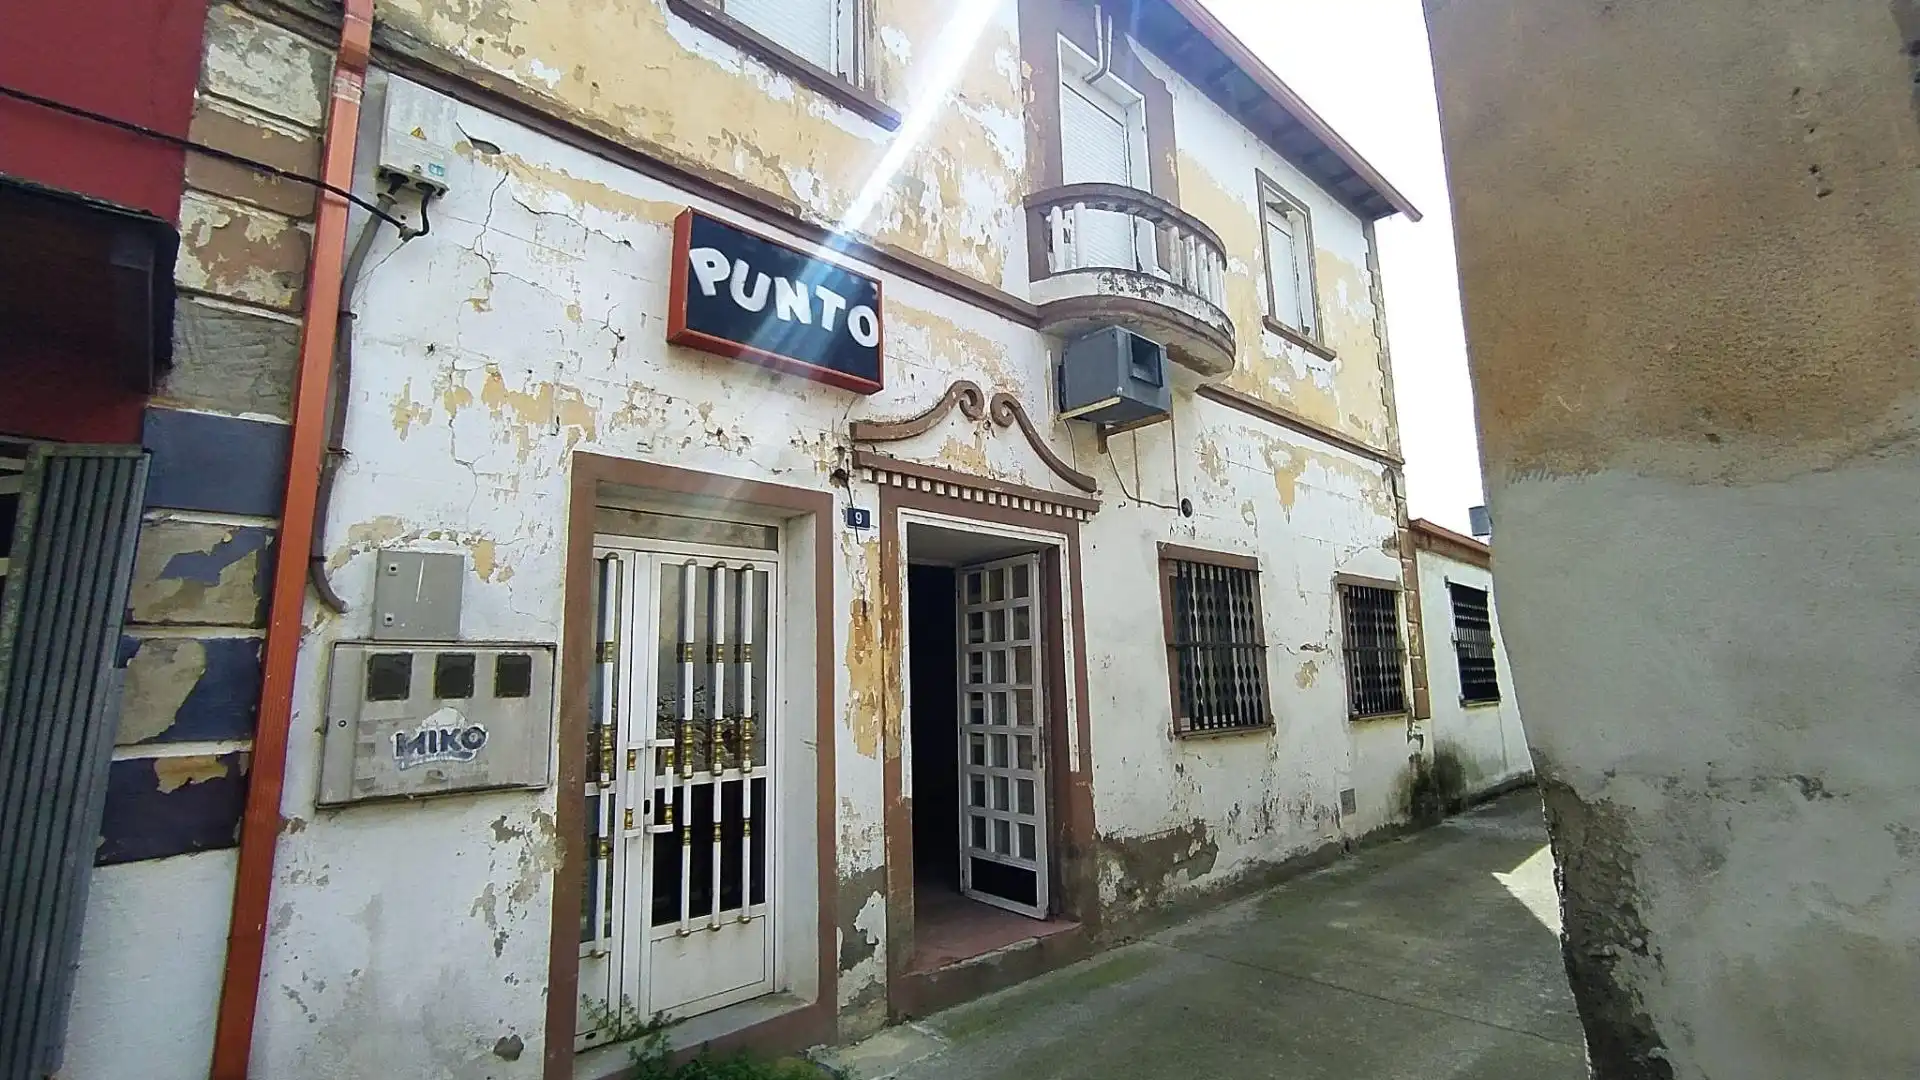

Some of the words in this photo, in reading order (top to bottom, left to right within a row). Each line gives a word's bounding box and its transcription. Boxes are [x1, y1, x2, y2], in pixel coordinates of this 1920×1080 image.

[688, 247, 879, 348] PUNTO
[854, 511, 863, 525] 9
[395, 725, 487, 758] MIKO
